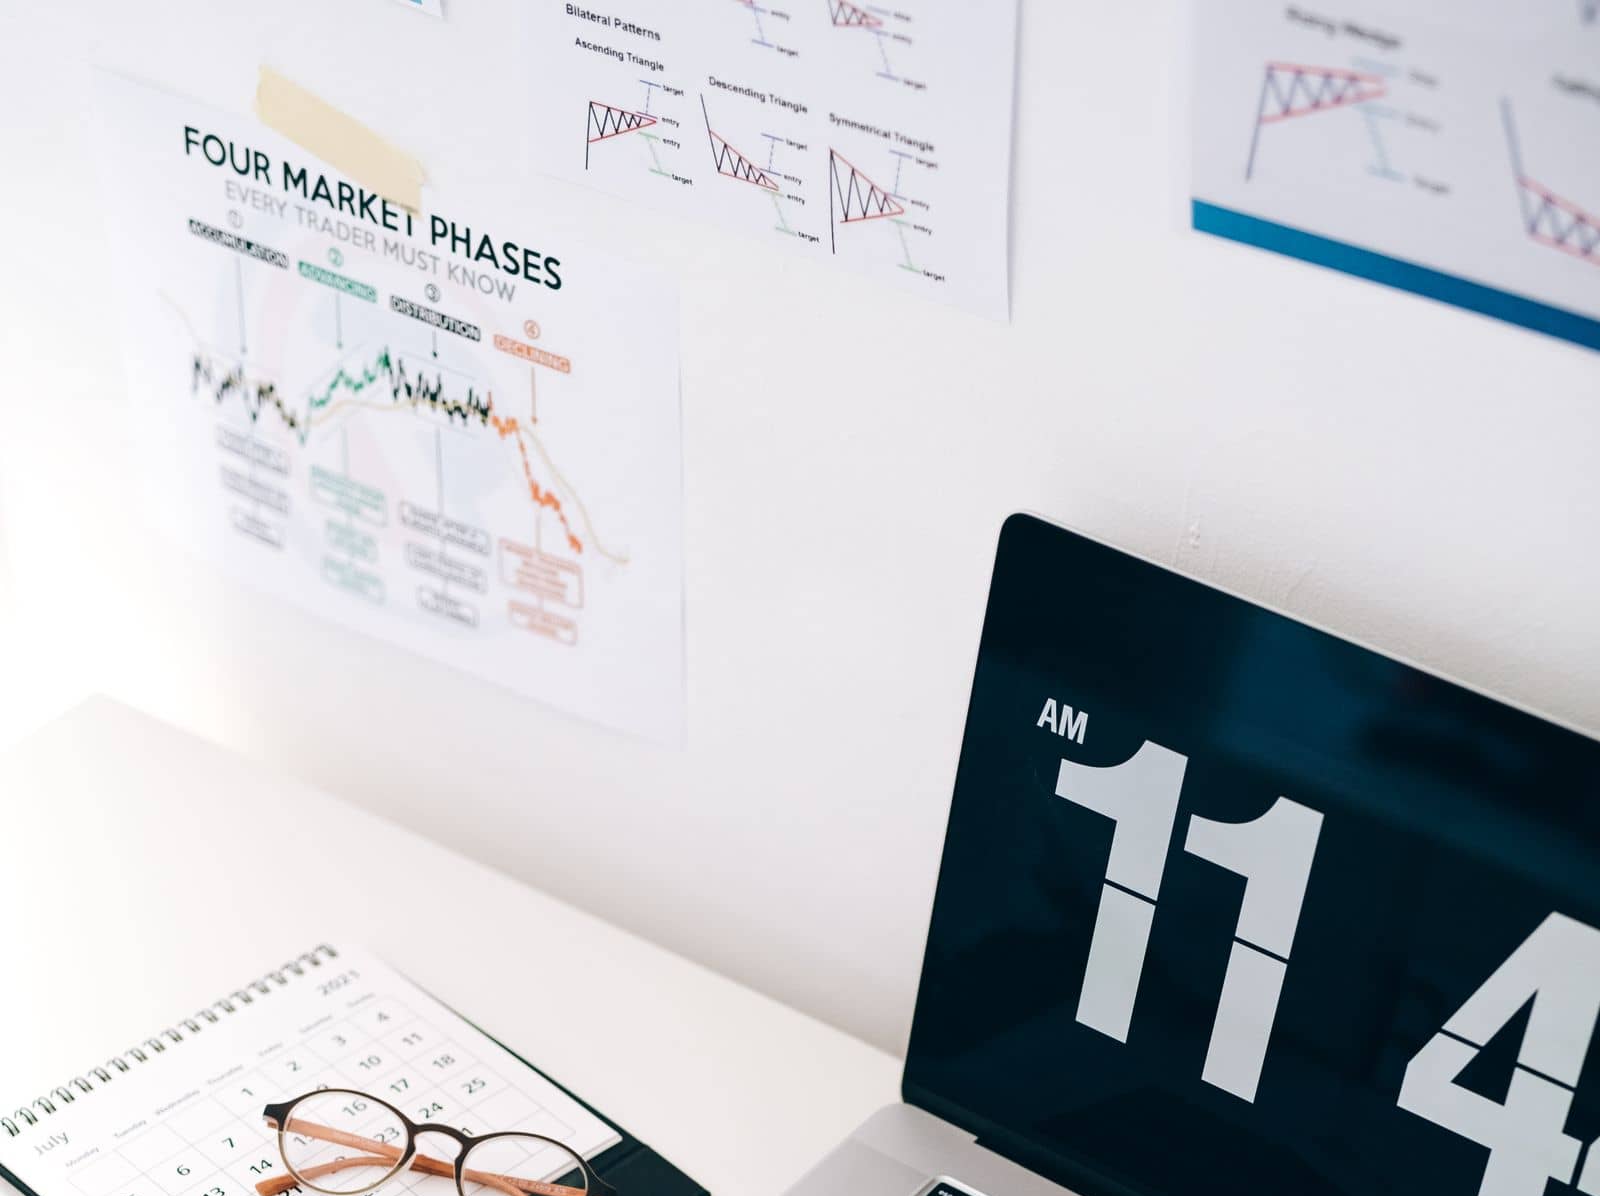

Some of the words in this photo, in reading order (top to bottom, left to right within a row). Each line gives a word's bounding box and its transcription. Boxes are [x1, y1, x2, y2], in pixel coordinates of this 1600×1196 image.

[566, 3, 610, 27] Bilateral
[614, 17, 661, 41] Patterns
[575, 37, 624, 62] Ascending
[626, 52, 664, 72] Triangle
[663, 84, 684, 96] target
[708, 75, 766, 104] Descending
[769, 94, 808, 114] Triangle
[662, 116, 680, 128] entry
[829, 112, 890, 139] Symmetrical
[894, 132, 935, 153] Triangle
[663, 137, 680, 149] entry
[786, 138, 808, 150] target
[672, 173, 693, 186] target
[784, 174, 802, 185] entry
[184, 125, 271, 185] FOUR
[283, 161, 418, 236] MARKET
[431, 214, 562, 290] PHASES
[787, 194, 805, 205] entry
[225, 180, 288, 220] EVERY
[293, 205, 376, 251] TRADER
[383, 238, 441, 275] MUST
[447, 261, 516, 303] KNOW
[798, 231, 820, 243] target
[923, 269, 945, 281] target
[390, 295, 481, 342] DISTRIBUTION
[1036, 698, 1088, 744] AM
[1054, 739, 1324, 1104] 11
[241, 1087, 254, 1097] 1
[287, 1060, 301, 1073] 2
[332, 1034, 347, 1046] 3
[176, 1164, 191, 1176] 6
[221, 1137, 236, 1149] 7
[359, 1054, 382, 1070] 10
[402, 1032, 423, 1046] 11
[250, 1159, 273, 1175] 14
[342, 1099, 368, 1117] 16
[390, 1077, 410, 1093] 17
[432, 1054, 456, 1069] 18
[374, 1126, 400, 1143] 23
[418, 1102, 444, 1119] 24
[461, 1077, 487, 1094] 25
[34, 1132, 69, 1156] July
